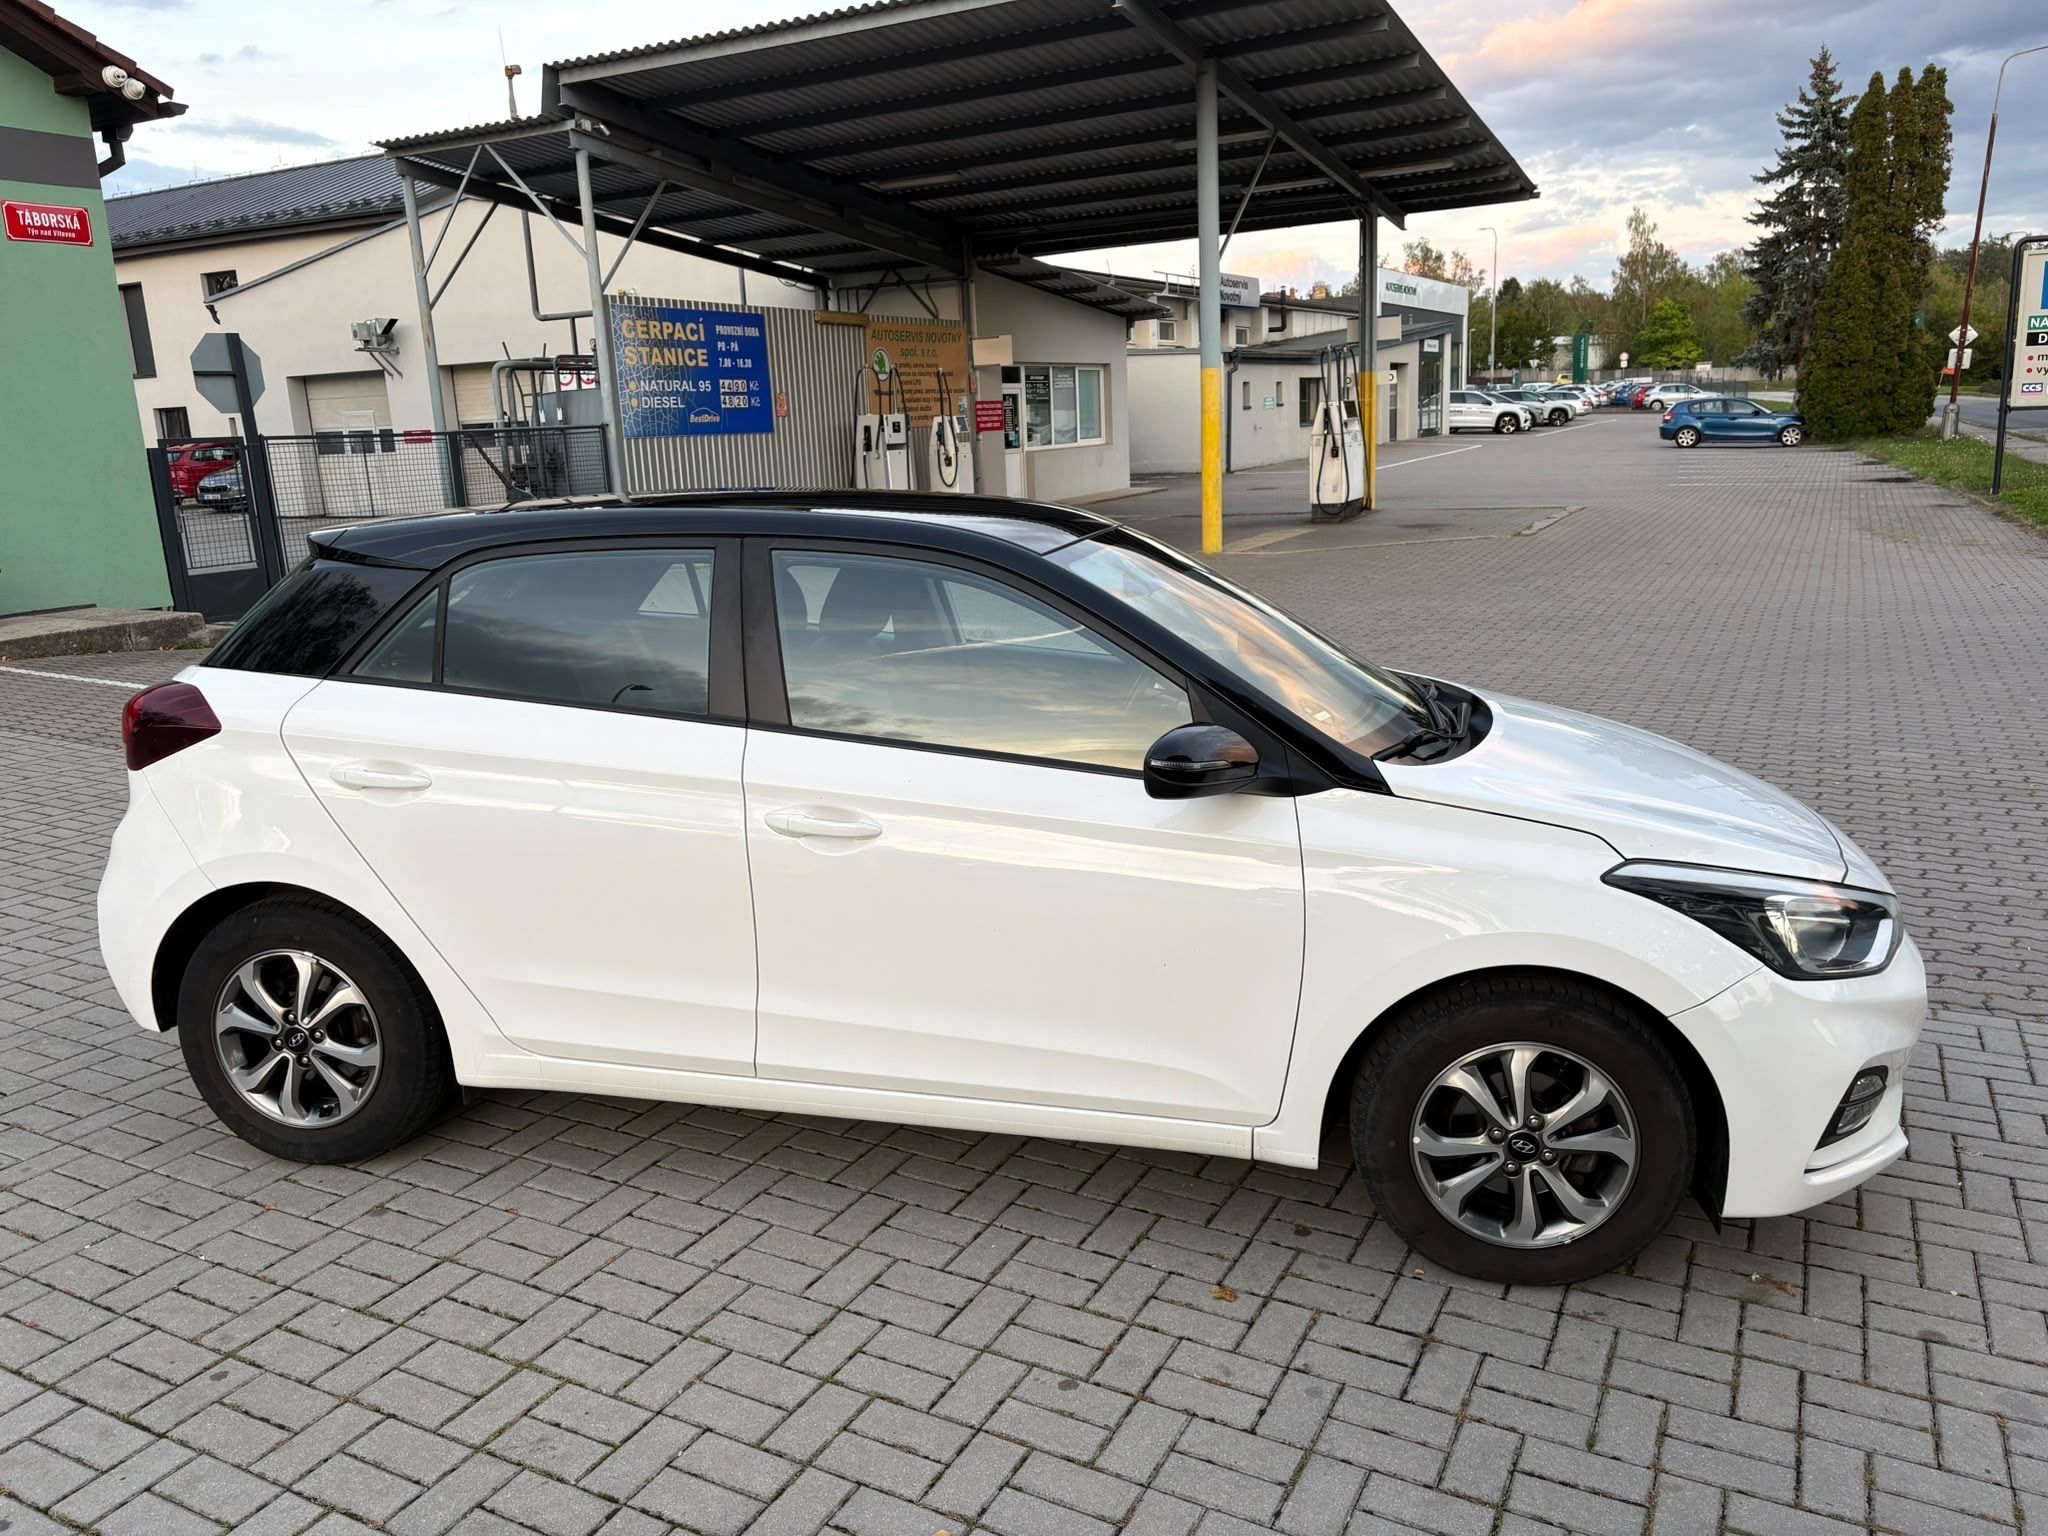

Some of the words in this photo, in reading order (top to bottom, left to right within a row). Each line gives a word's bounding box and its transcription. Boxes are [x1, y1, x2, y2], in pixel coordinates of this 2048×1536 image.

[16, 209, 80, 230] TÁBORSKÁ
[27, 227, 39, 237] Týn
[621, 312, 706, 342] ČERPACÍ
[871, 328, 925, 342] AUTOSERVIS
[924, 330, 962, 344] NOVOTNÝ
[624, 345, 709, 367] STANICE
[640, 379, 697, 392] NATURAL
[698, 380, 712, 392] 95
[2022, 384, 2043, 392] CCS
[641, 396, 686, 409] DIESEL
